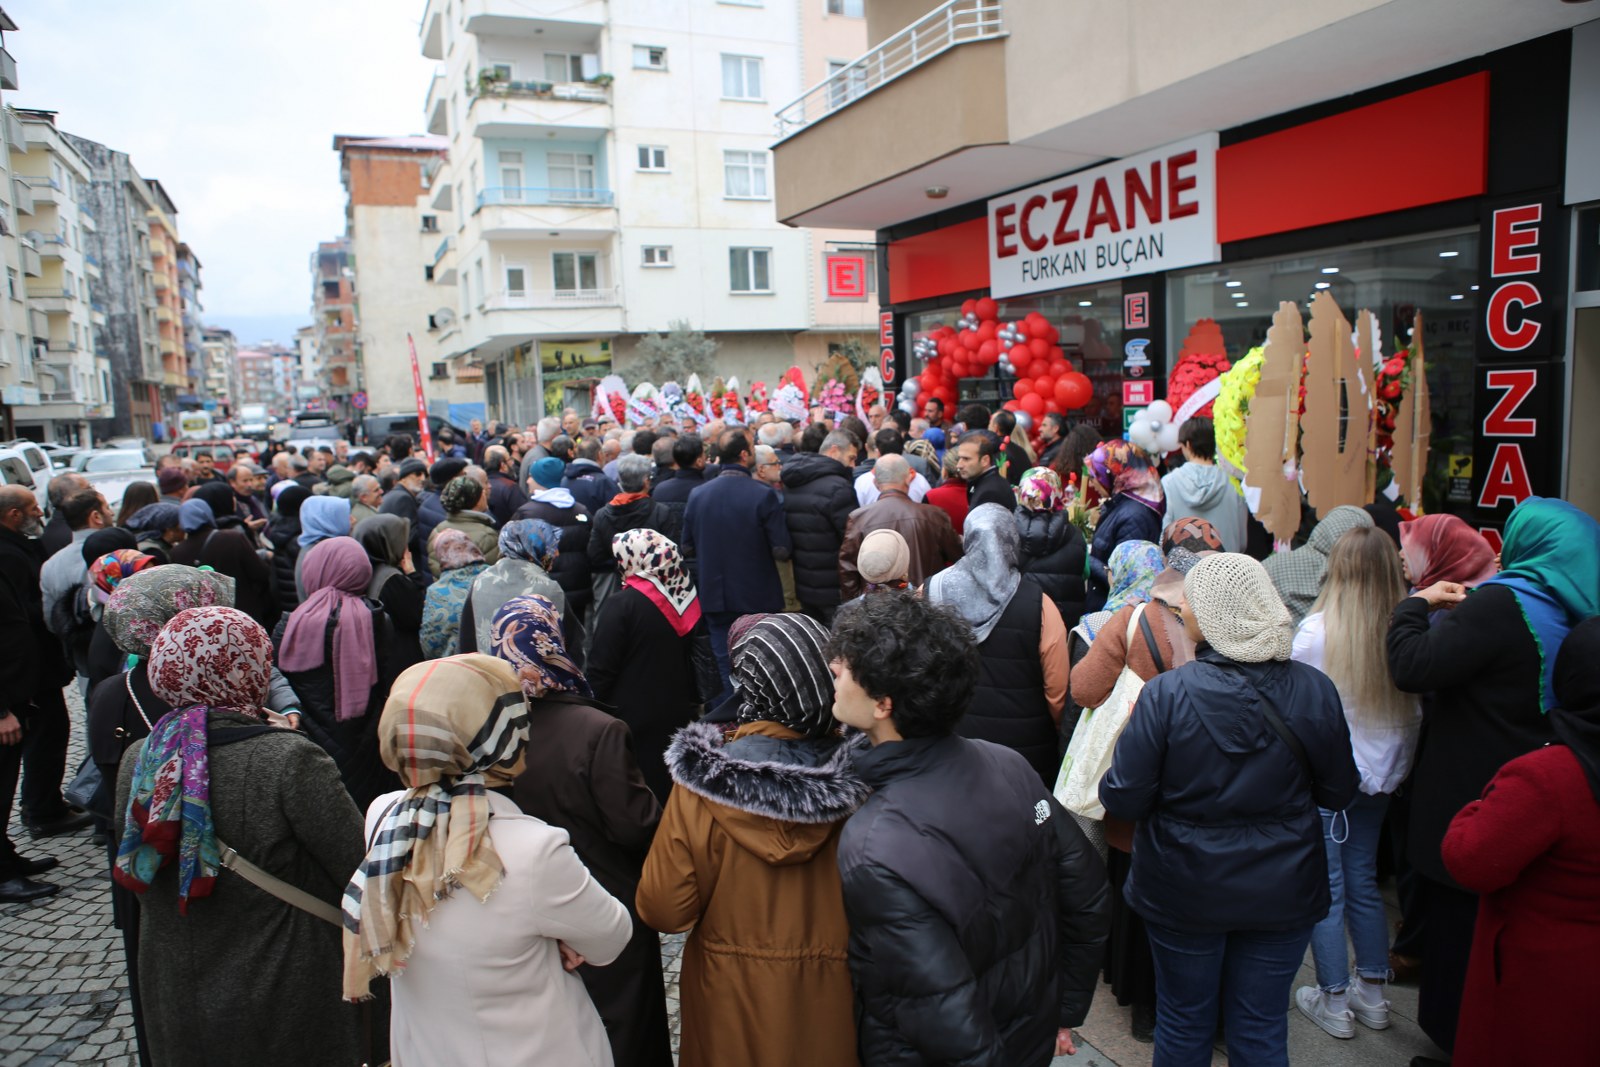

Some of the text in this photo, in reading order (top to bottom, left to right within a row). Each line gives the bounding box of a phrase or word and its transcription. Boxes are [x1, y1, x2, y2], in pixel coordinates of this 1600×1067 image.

[995, 149, 1199, 259] ECZANE
[1022, 232, 1163, 282] FURKAN BUÇAN
